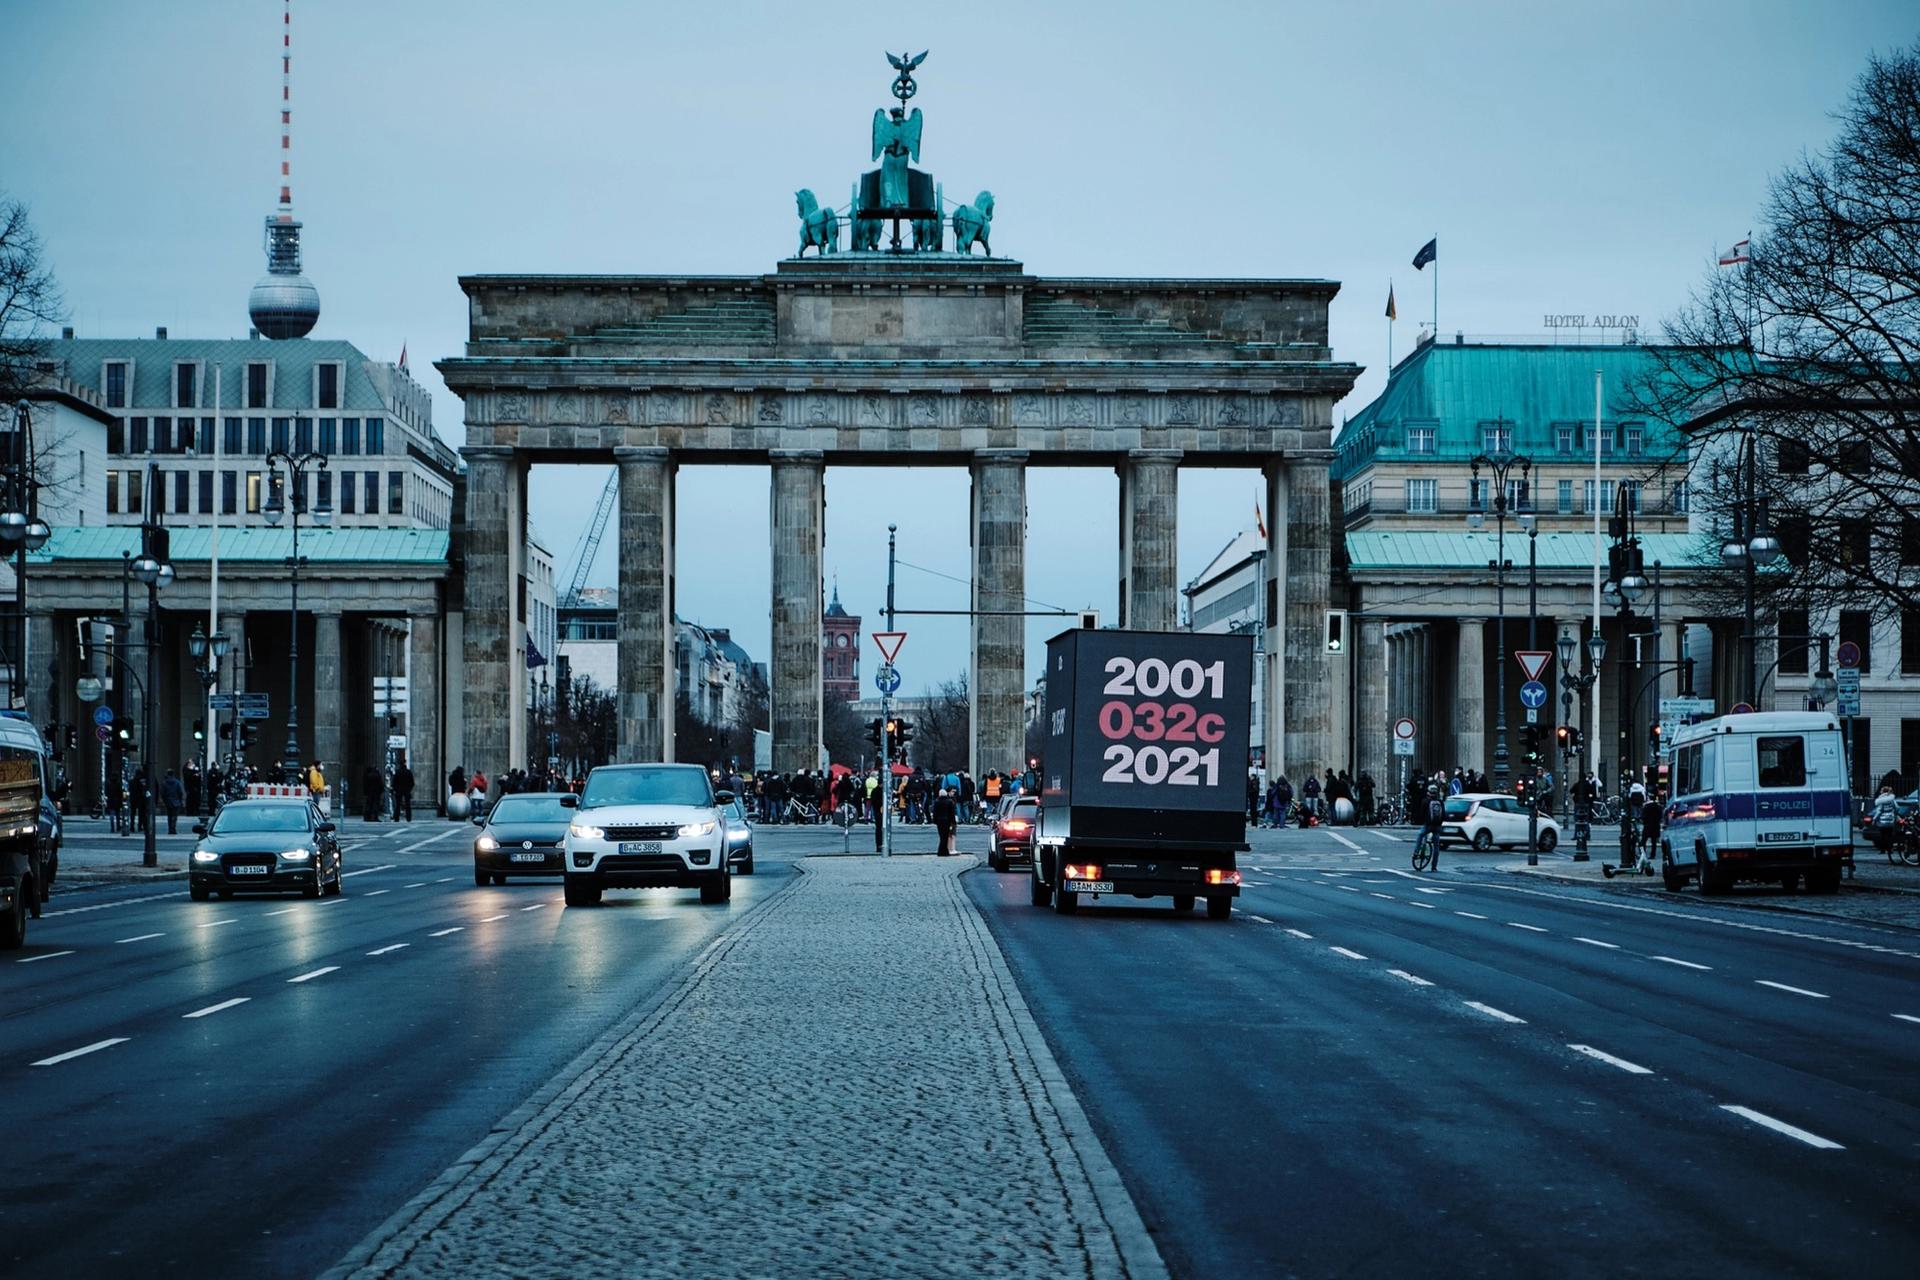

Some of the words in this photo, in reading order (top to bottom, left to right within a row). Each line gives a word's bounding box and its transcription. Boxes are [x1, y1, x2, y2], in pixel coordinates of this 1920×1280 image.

[1544, 314, 1589, 328] HOTEL
[1593, 314, 1639, 328] ADLON
[1103, 656, 1225, 699] 2001
[1099, 700, 1226, 744] 032c
[1102, 744, 1220, 786] 2021
[1772, 800, 1811, 810] POLIZEI
